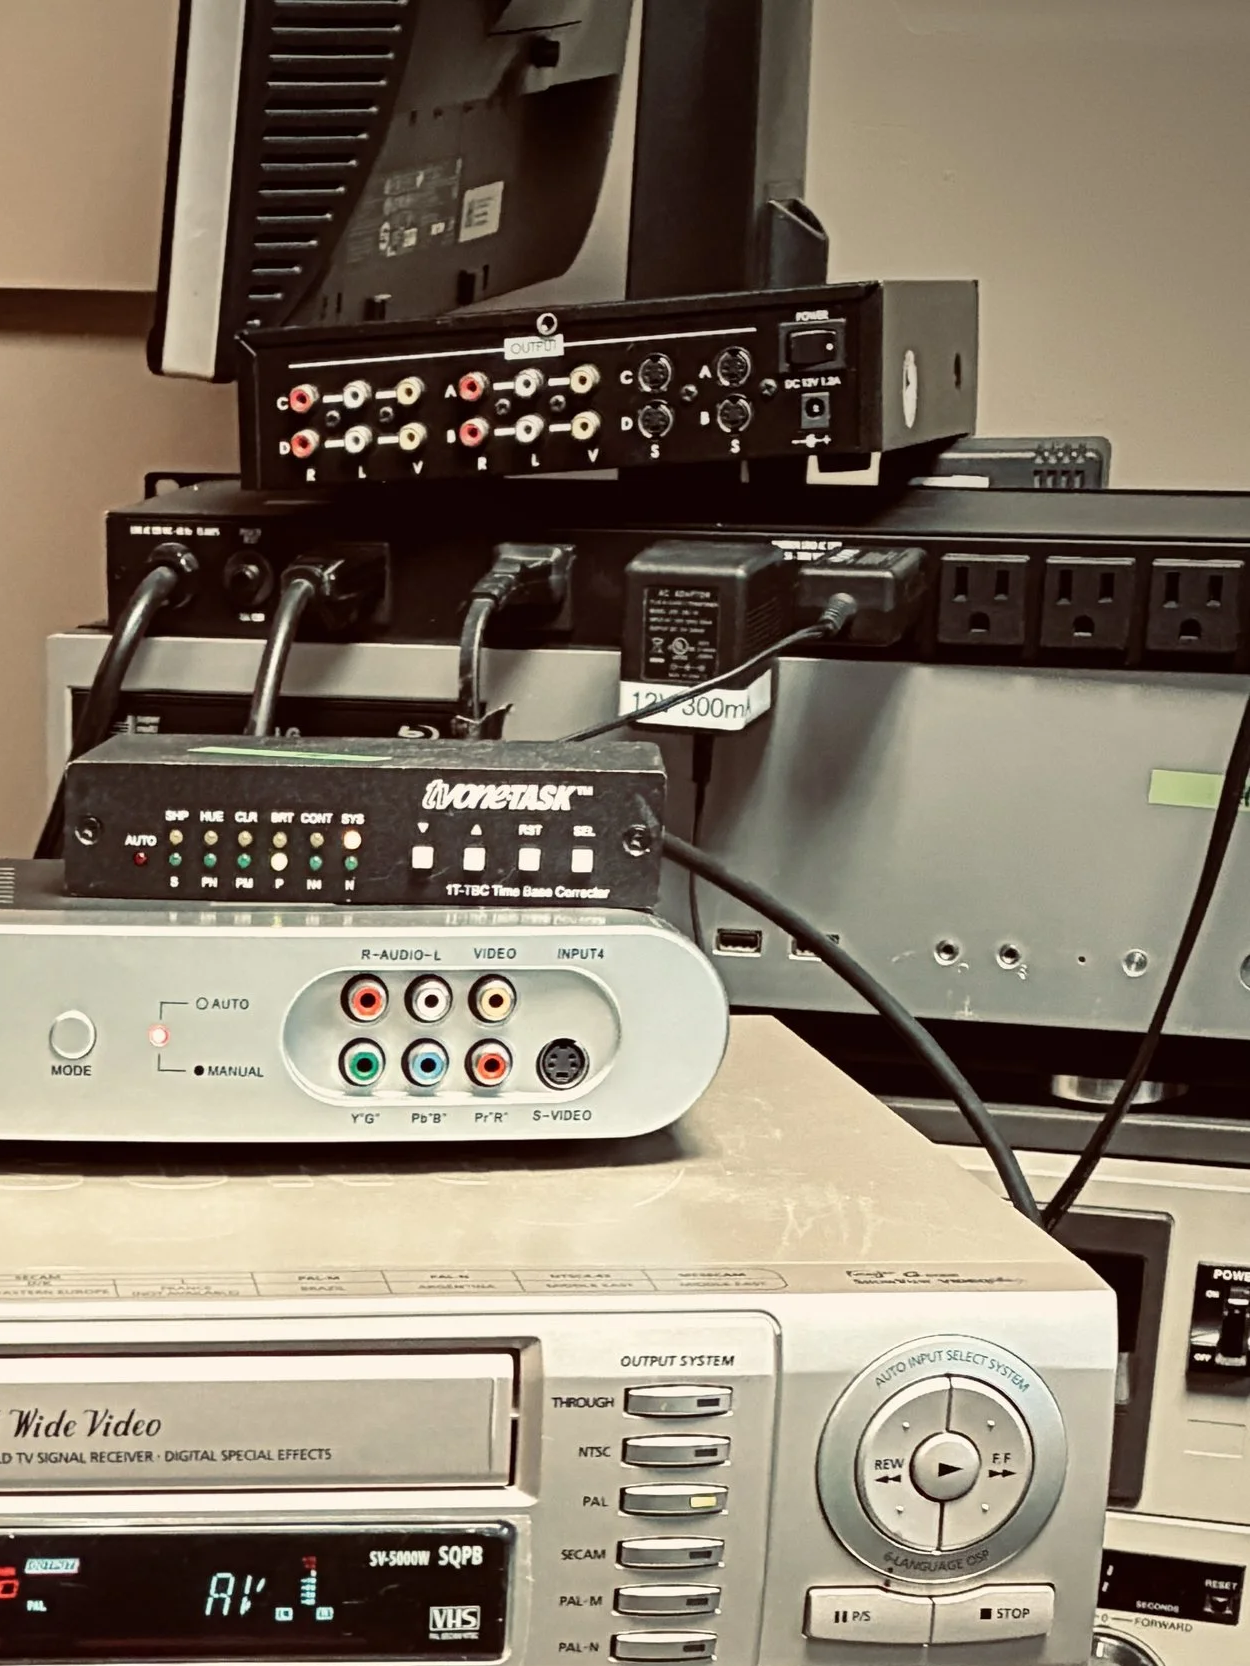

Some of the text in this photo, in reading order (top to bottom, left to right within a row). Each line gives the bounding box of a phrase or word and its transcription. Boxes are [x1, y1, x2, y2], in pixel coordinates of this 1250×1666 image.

[795, 310, 829, 321] POWER
[509, 339, 558, 355] OUTPUT
[619, 370, 633, 385] C
[699, 365, 712, 379] A
[445, 384, 457, 399] A
[276, 396, 289, 411] C
[620, 416, 633, 431] D
[279, 441, 290, 455] D
[531, 454, 540, 467] L
[588, 448, 599, 463] V
[412, 460, 424, 475] V
[477, 456, 488, 470] R
[306, 468, 316, 481] R
[358, 465, 367, 479] L
[165, 810, 189, 821] SHP
[200, 811, 225, 823] HUE
[234, 811, 259, 823] CLR
[270, 812, 295, 824] BRT
[300, 812, 333, 824] CONT
[341, 813, 365, 825] SYS
[518, 824, 543, 836] RST
[573, 825, 596, 837] SEL
[125, 834, 158, 847] AUTO
[446, 884, 610, 899] 1T-TBC Time Base Corrector
[473, 947, 517, 960] VIDEO
[557, 947, 605, 961] INPUT4
[210, 997, 250, 1011] AUTO
[50, 1064, 92, 1077] MODE
[207, 1064, 264, 1078] MANUAL
[532, 1108, 593, 1122] S-VIDEO
[620, 1355, 735, 1367] OUTPUT SYSTEM
[874, 1349, 1031, 1393] AUTO INPUT SELECT SYSTEM
[551, 1397, 615, 1408] THROUGH
[9, 1408, 77, 1439] Wide
[83, 1408, 162, 1439] Video
[16, 1451, 33, 1464] TV
[37, 1451, 86, 1465] SIGNAL
[90, 1450, 154, 1464] RECEIVER
[164, 1449, 218, 1463] DIGITAL
[221, 1449, 275, 1463] SPECIAL
[278, 1448, 332, 1462] EFFECTS
[578, 1446, 611, 1458] NTSC
[874, 1458, 905, 1470] REW
[582, 1495, 608, 1507] PAL
[369, 1545, 484, 1568] SV-5000W SQPB
[561, 1549, 606, 1560] SECAM
[1204, 1578, 1237, 1591] RESET
[26, 1600, 47, 1612] PAL
[559, 1595, 603, 1606] PAL-M
[1135, 1600, 1180, 1613] SECONDS
[431, 1607, 479, 1629] VHS
[852, 1610, 871, 1622] P/S
[996, 1608, 1030, 1619] STOP
[1134, 1617, 1193, 1633] FORWARD
[558, 1642, 599, 1653] PAL-N
